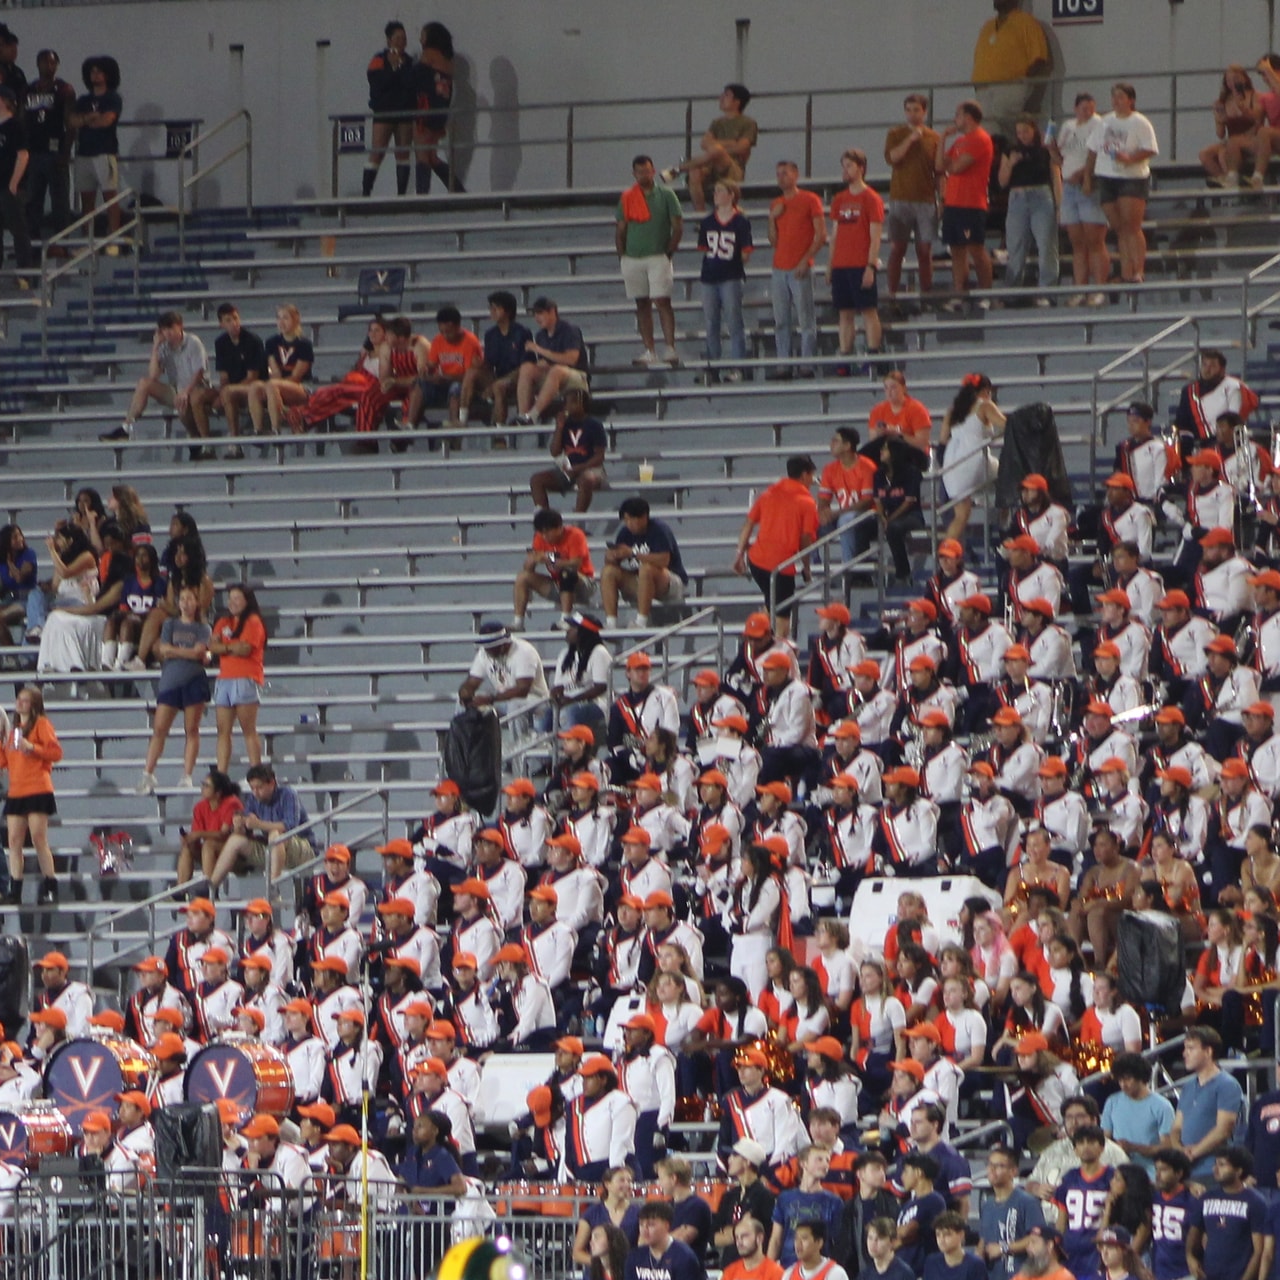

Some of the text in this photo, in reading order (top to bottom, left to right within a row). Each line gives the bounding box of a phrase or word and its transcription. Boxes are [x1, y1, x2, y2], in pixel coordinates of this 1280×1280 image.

[706, 230, 736, 260] 95
[278, 346, 295, 366] V
[569, 429, 584, 448] V
[66, 1055, 104, 1098] V
[204, 1059, 239, 1097] V
[1066, 1189, 1109, 1231] 95
